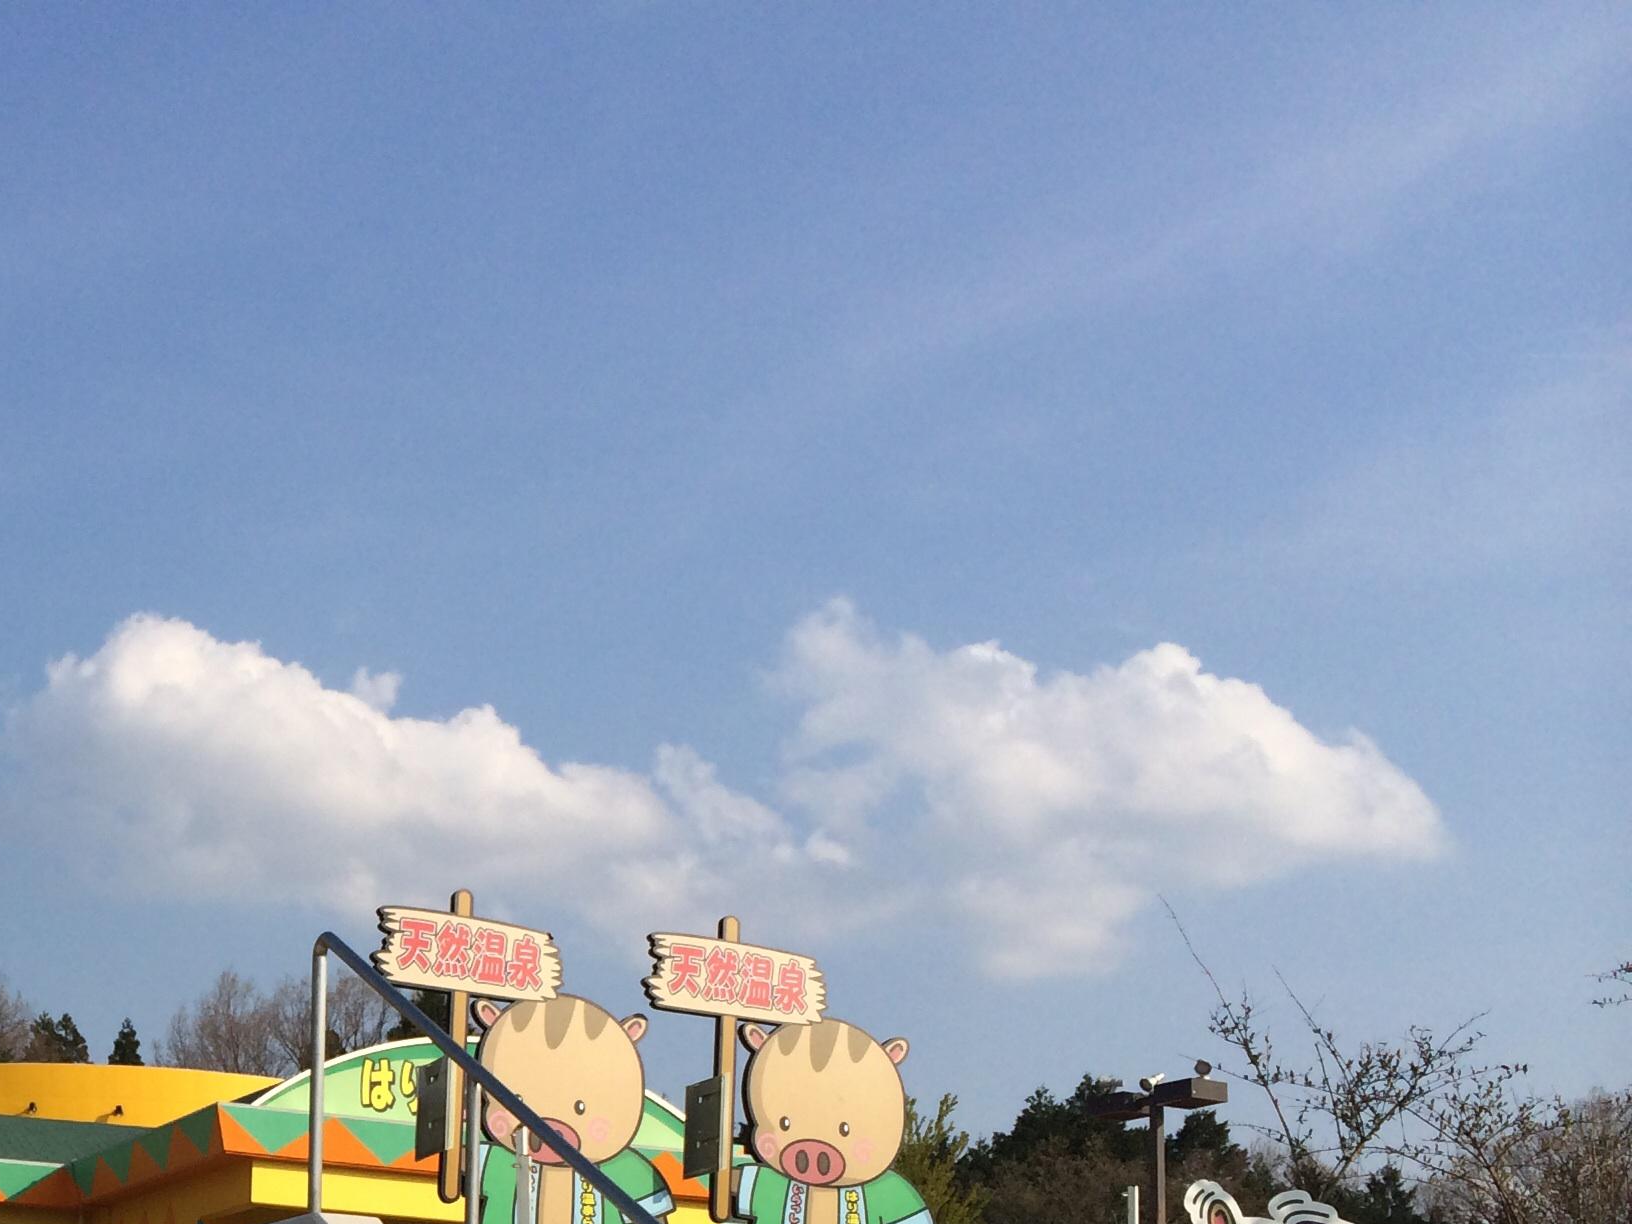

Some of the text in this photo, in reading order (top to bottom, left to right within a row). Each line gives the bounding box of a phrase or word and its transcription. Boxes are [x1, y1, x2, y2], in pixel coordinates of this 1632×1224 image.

[396, 917, 543, 990] 天然温泉
[668, 943, 808, 1015] 天然温泉
